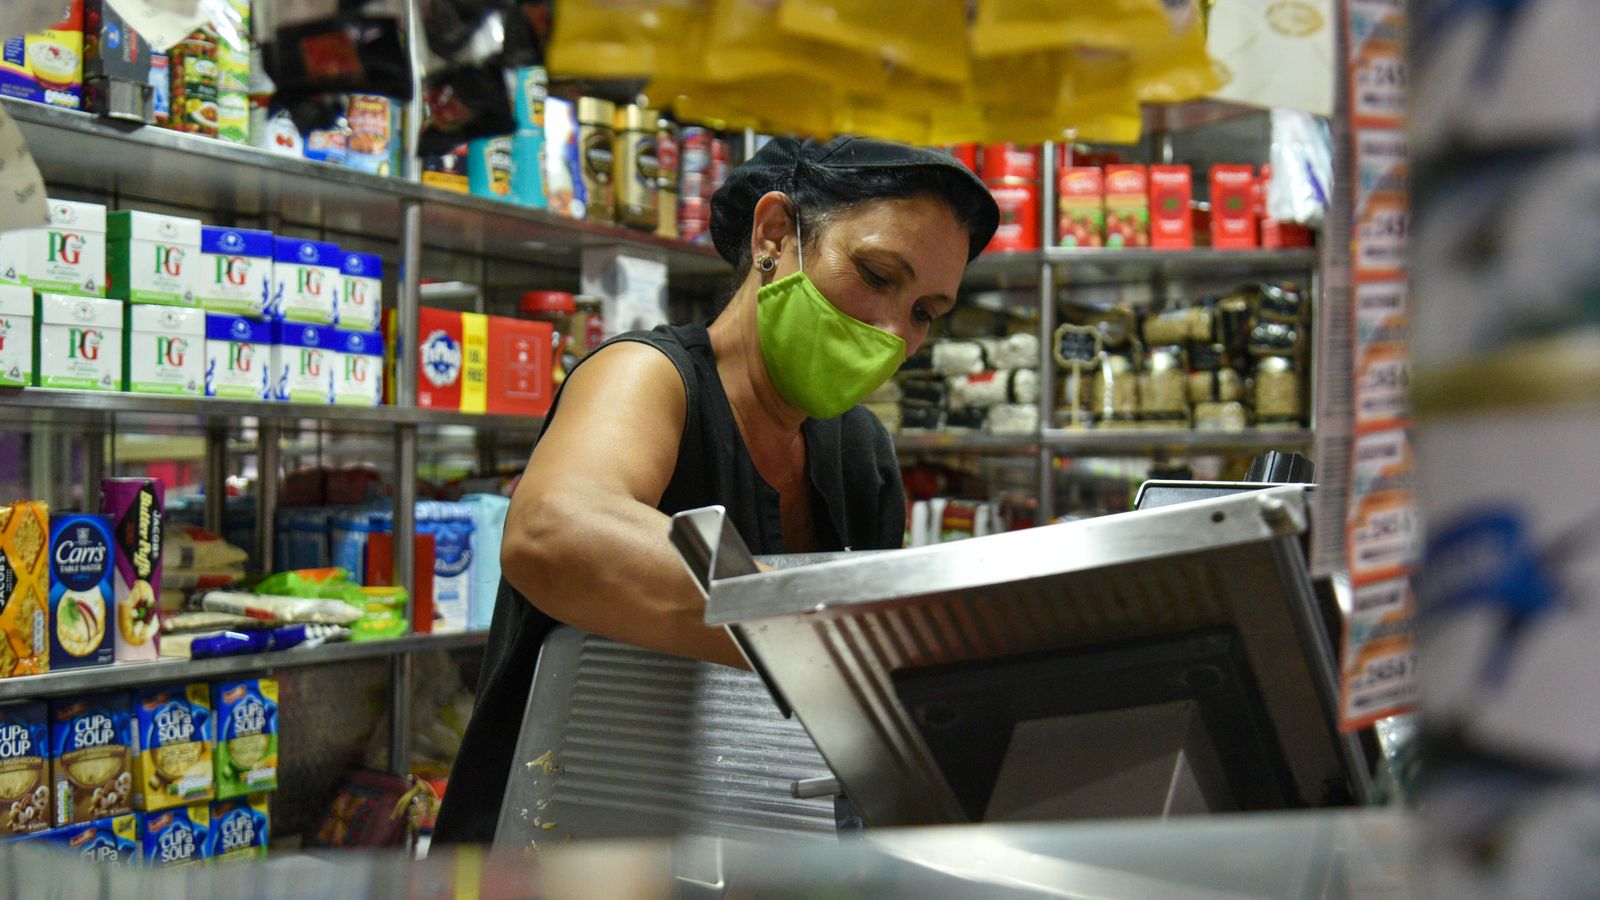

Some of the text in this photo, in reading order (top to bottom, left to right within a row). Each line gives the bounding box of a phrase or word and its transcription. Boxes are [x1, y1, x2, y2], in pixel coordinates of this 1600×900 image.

[47, 232, 80, 265] PG
[154, 245, 181, 276] PG
[215, 256, 246, 285] PG
[296, 267, 321, 295] PG
[343, 277, 365, 305] PG
[68, 327, 99, 360] PG
[156, 336, 184, 366] PG
[228, 342, 251, 372] PG
[299, 348, 321, 376] PG
[344, 355, 366, 383] PG
[56, 541, 106, 565] Carr's
[0, 725, 29, 742] UPa
[74, 729, 114, 748] SOUP
[158, 723, 194, 742] SOUP
[234, 716, 266, 733] SOUP
[0, 740, 31, 757] OUP
[222, 829, 255, 849] SOUP
[161, 844, 195, 863] SOUP
